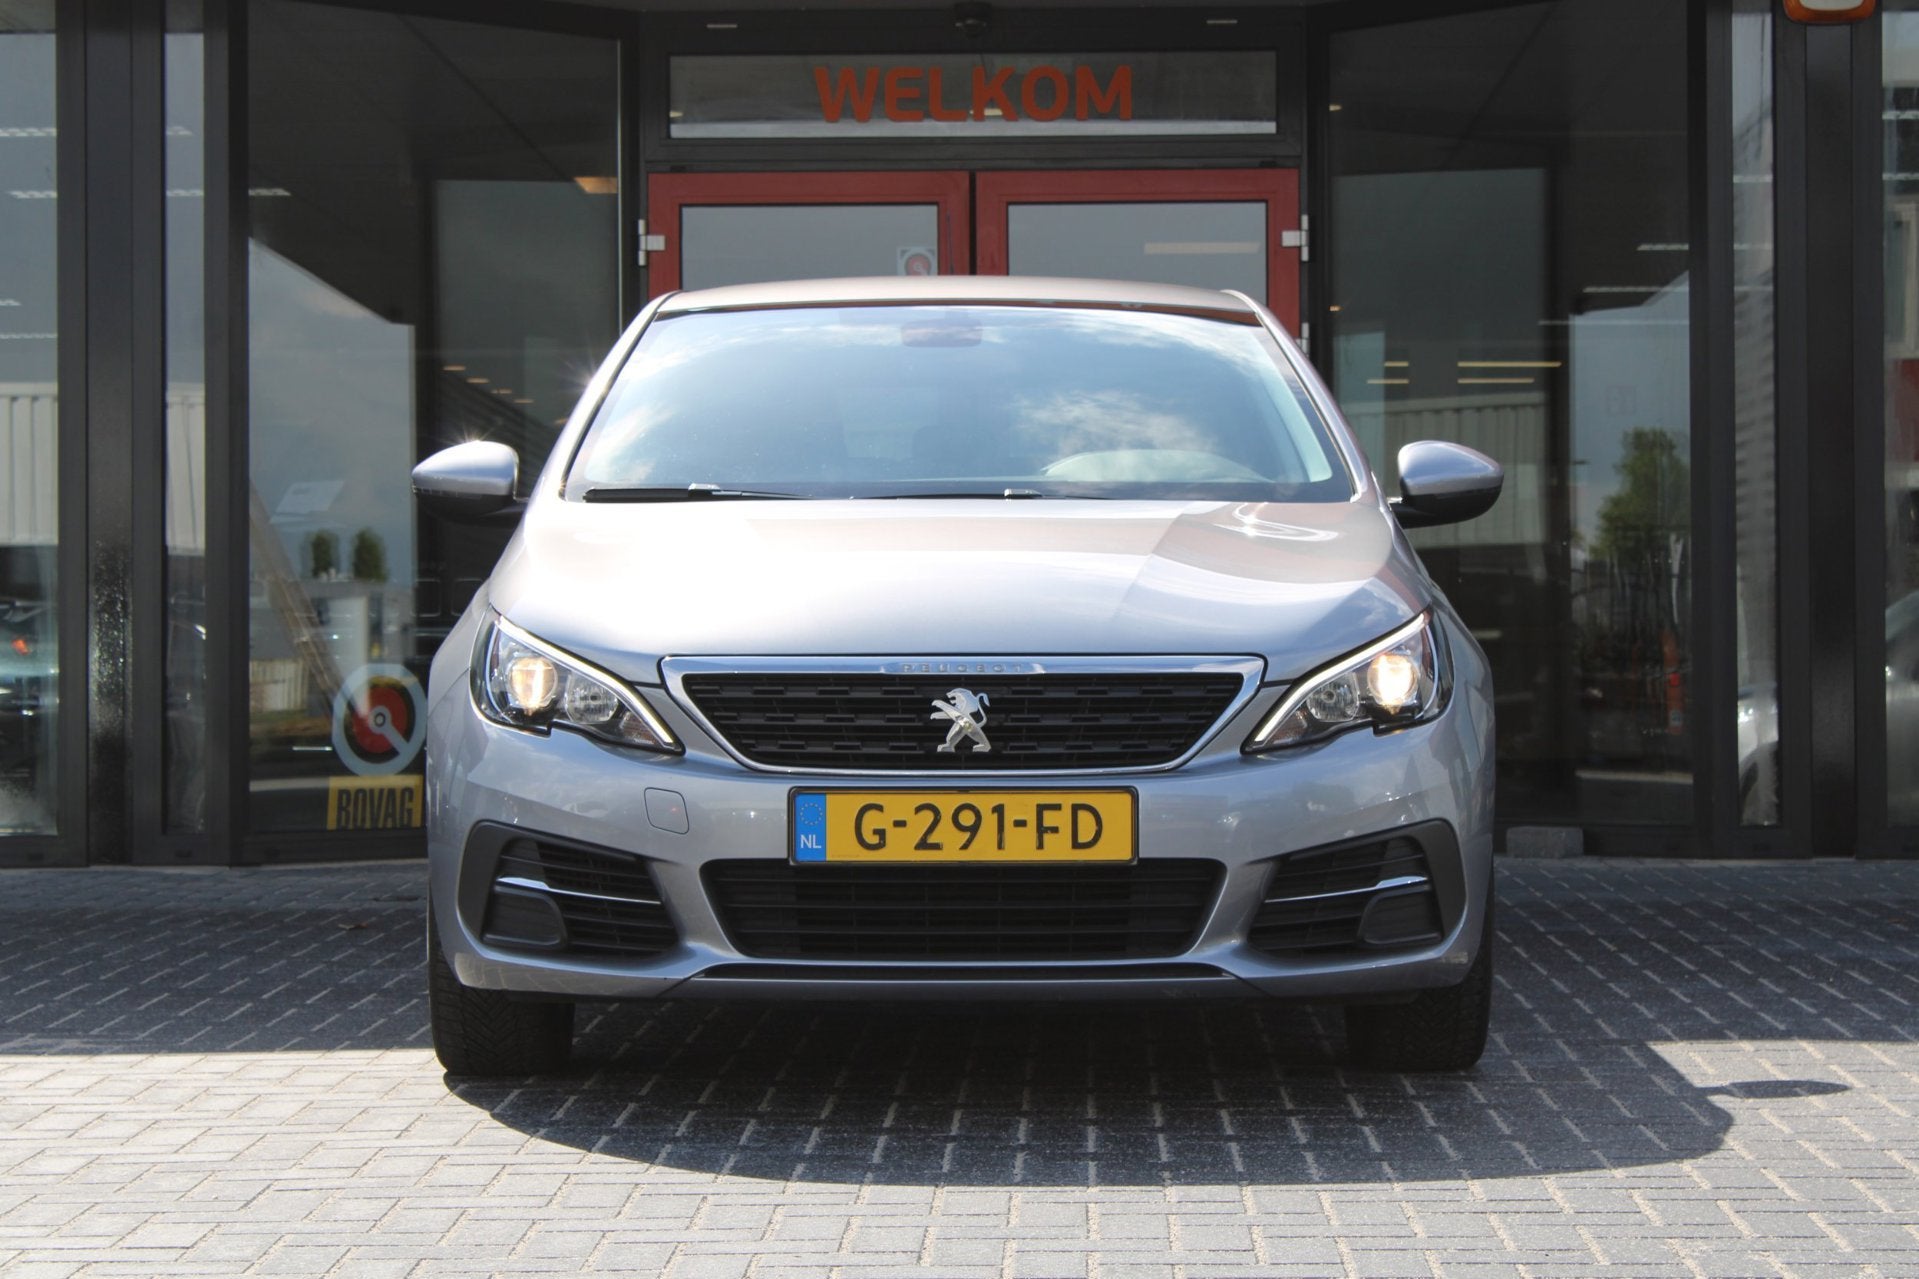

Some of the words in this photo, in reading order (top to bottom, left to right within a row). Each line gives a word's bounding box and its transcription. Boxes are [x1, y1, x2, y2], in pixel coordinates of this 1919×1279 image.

[814, 65, 1133, 123] WELKOM
[902, 663, 1022, 673] PEUGEOT
[337, 787, 414, 829] BOVAG
[854, 802, 1103, 851] G-291-FD
[800, 834, 822, 849] NL
